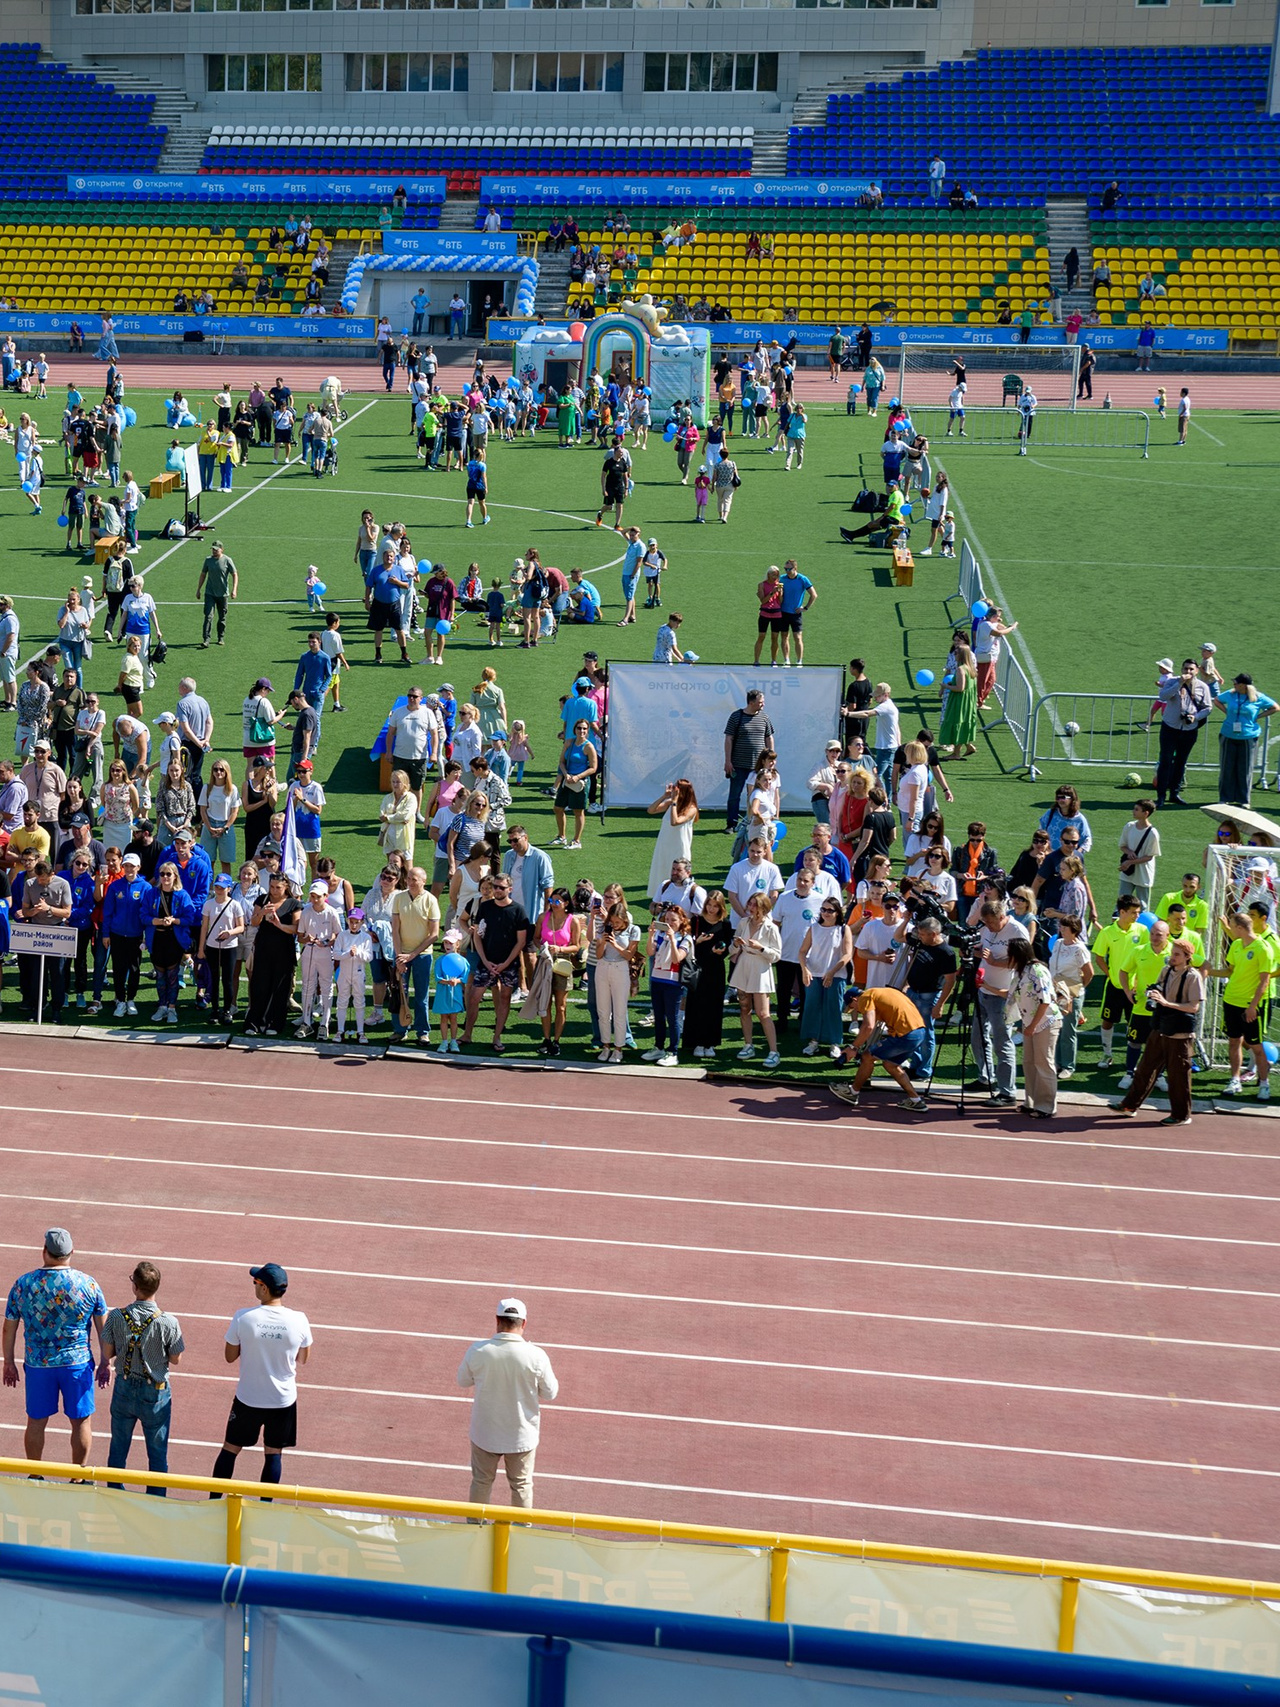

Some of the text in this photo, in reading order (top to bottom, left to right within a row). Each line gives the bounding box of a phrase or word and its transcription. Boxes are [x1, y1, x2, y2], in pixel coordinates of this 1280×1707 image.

[87, 180, 435, 193] открытие открытие ВТБ ВТБ ВТБ ВТБ ВТБ ВТБ
[500, 185, 517, 194] ВТБ
[542, 186, 559, 194] ВТБ
[585, 186, 602, 195] ВТБ
[631, 186, 648, 195] ВТБ
[674, 187, 691, 195] ВТБ
[718, 187, 735, 195] ВТБ
[766, 184, 809, 193] открытие
[402, 240, 506, 250] ВТБ ВТБ ВТБ
[17, 318, 35, 328] ВТБ
[123, 320, 140, 329] ВТБ
[167, 321, 184, 330] ВТБ
[257, 322, 275, 332] ВТБ
[301, 323, 319, 333] ВТБ
[346, 324, 364, 334] ВТБ
[743, 329, 762, 339] ВТБ
[909, 332, 945, 341] открытие
[972, 333, 993, 343] ВТБ
[1094, 334, 1114, 344] ВТБ
[1195, 335, 1215, 345] ВТБ
[11, 929, 76, 942] Ханты-Мансийский
[33, 940, 53, 948] район
[1103, 1007, 1111, 1018] 8
